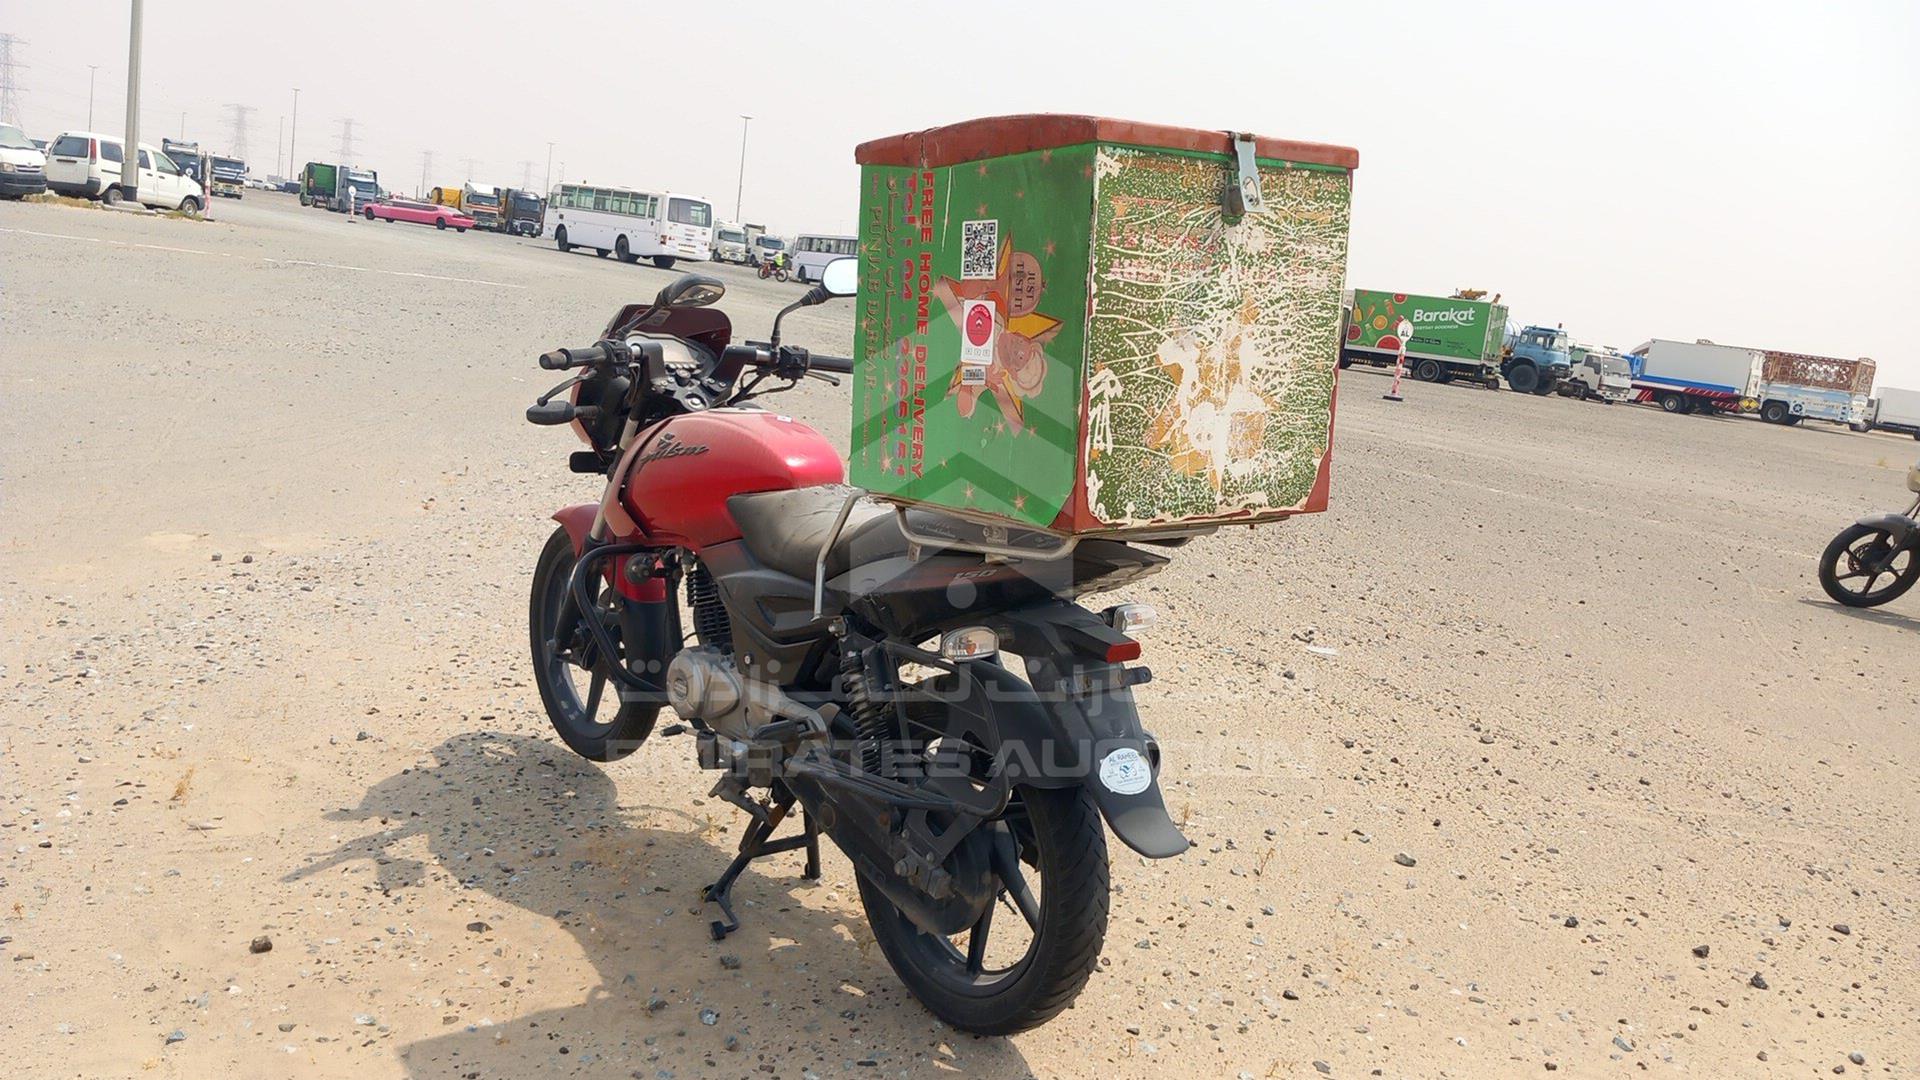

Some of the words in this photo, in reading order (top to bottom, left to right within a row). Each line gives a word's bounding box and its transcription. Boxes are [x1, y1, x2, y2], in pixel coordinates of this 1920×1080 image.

[902, 171, 917, 225] Tel
[920, 171, 935, 244] FREE
[867, 206, 883, 294] PUNJAB
[900, 259, 914, 300] 04
[916, 252, 932, 335] HOME
[1025, 271, 1037, 301] JUST
[1014, 297, 1023, 312] IT
[1413, 307, 1476, 326] Barakat
[911, 344, 928, 479] DELIVERY
[953, 568, 998, 580] 150
